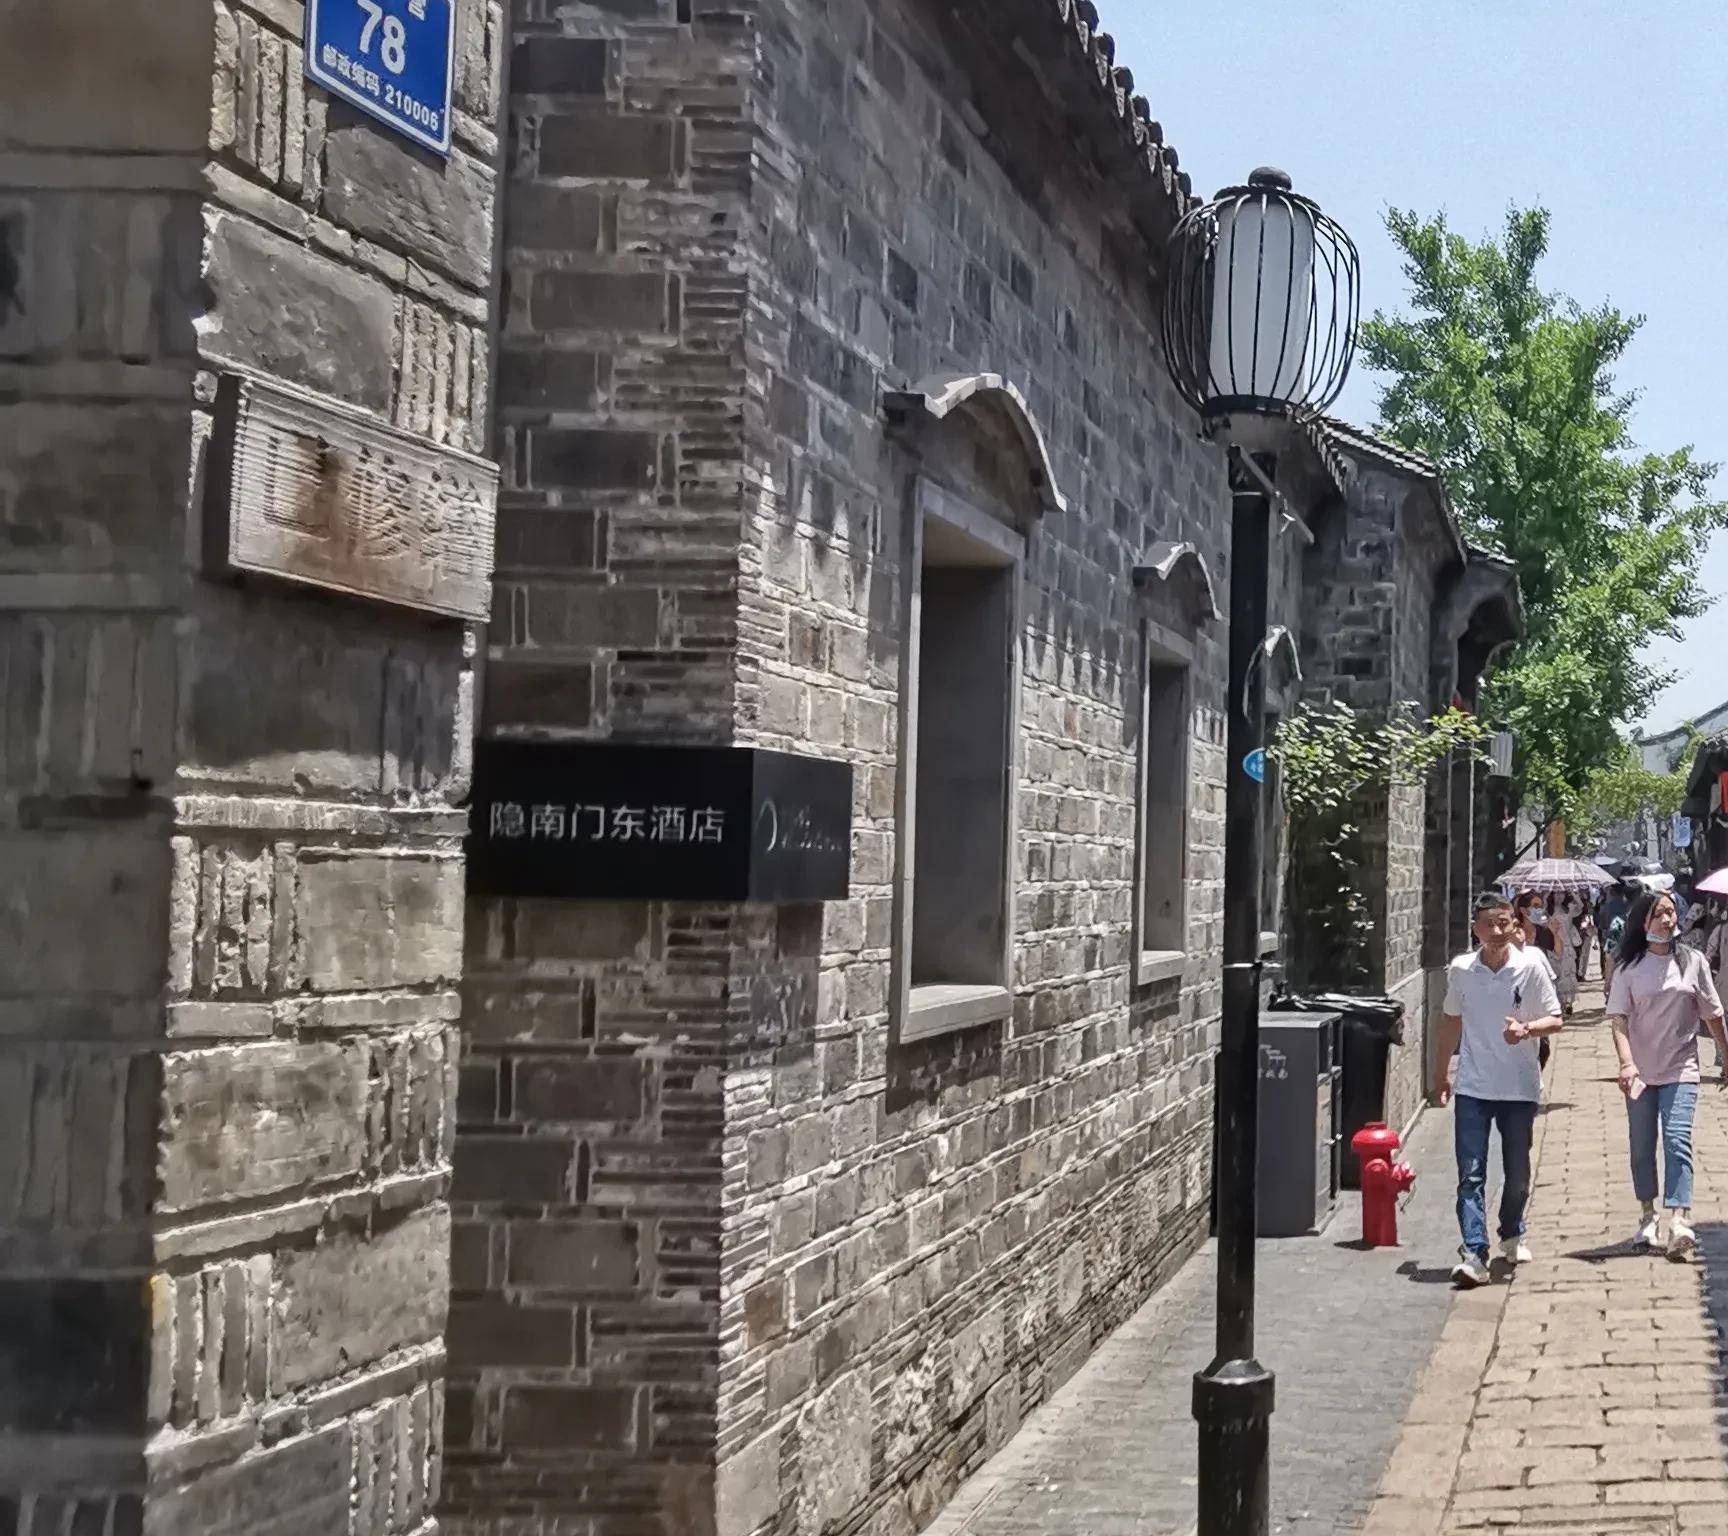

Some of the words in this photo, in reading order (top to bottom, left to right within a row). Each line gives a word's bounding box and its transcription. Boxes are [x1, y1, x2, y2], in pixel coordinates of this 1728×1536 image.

[383, 84, 439, 133] 210006
[490, 801, 726, 843] 隐南门东酒店
